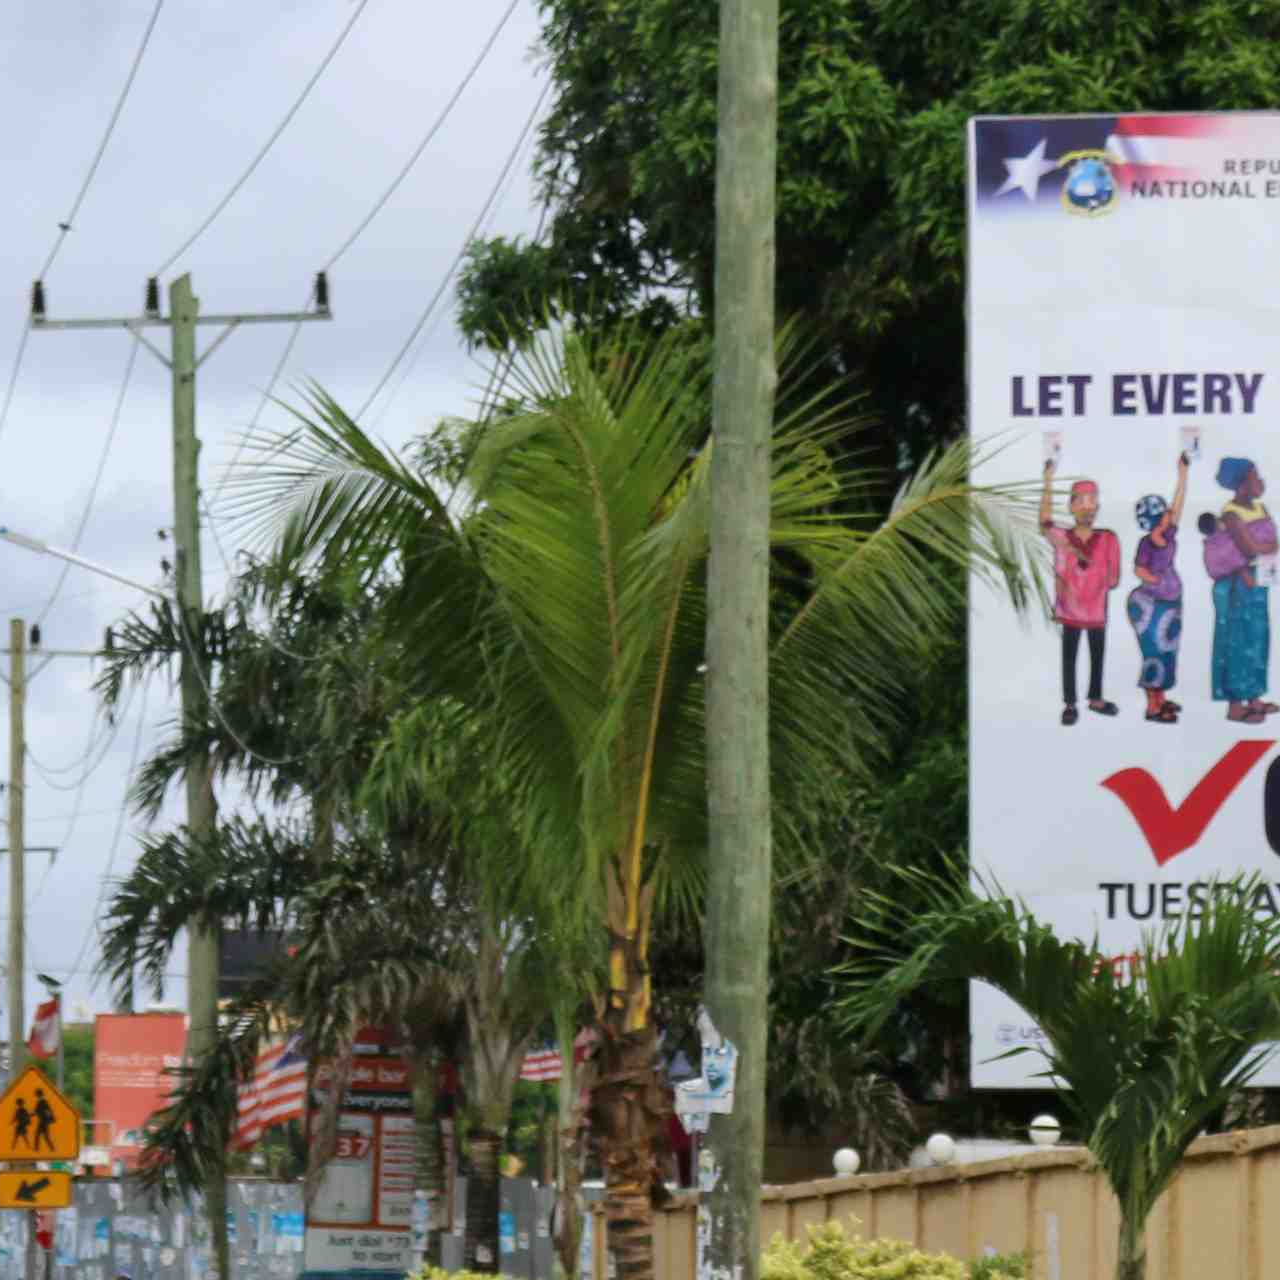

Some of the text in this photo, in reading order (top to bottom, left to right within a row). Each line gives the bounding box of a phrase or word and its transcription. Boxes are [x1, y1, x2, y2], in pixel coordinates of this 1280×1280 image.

[1130, 180, 1257, 199] NATIONAL
[1011, 374, 1093, 417] LET
[1111, 372, 1265, 416] EVERY
